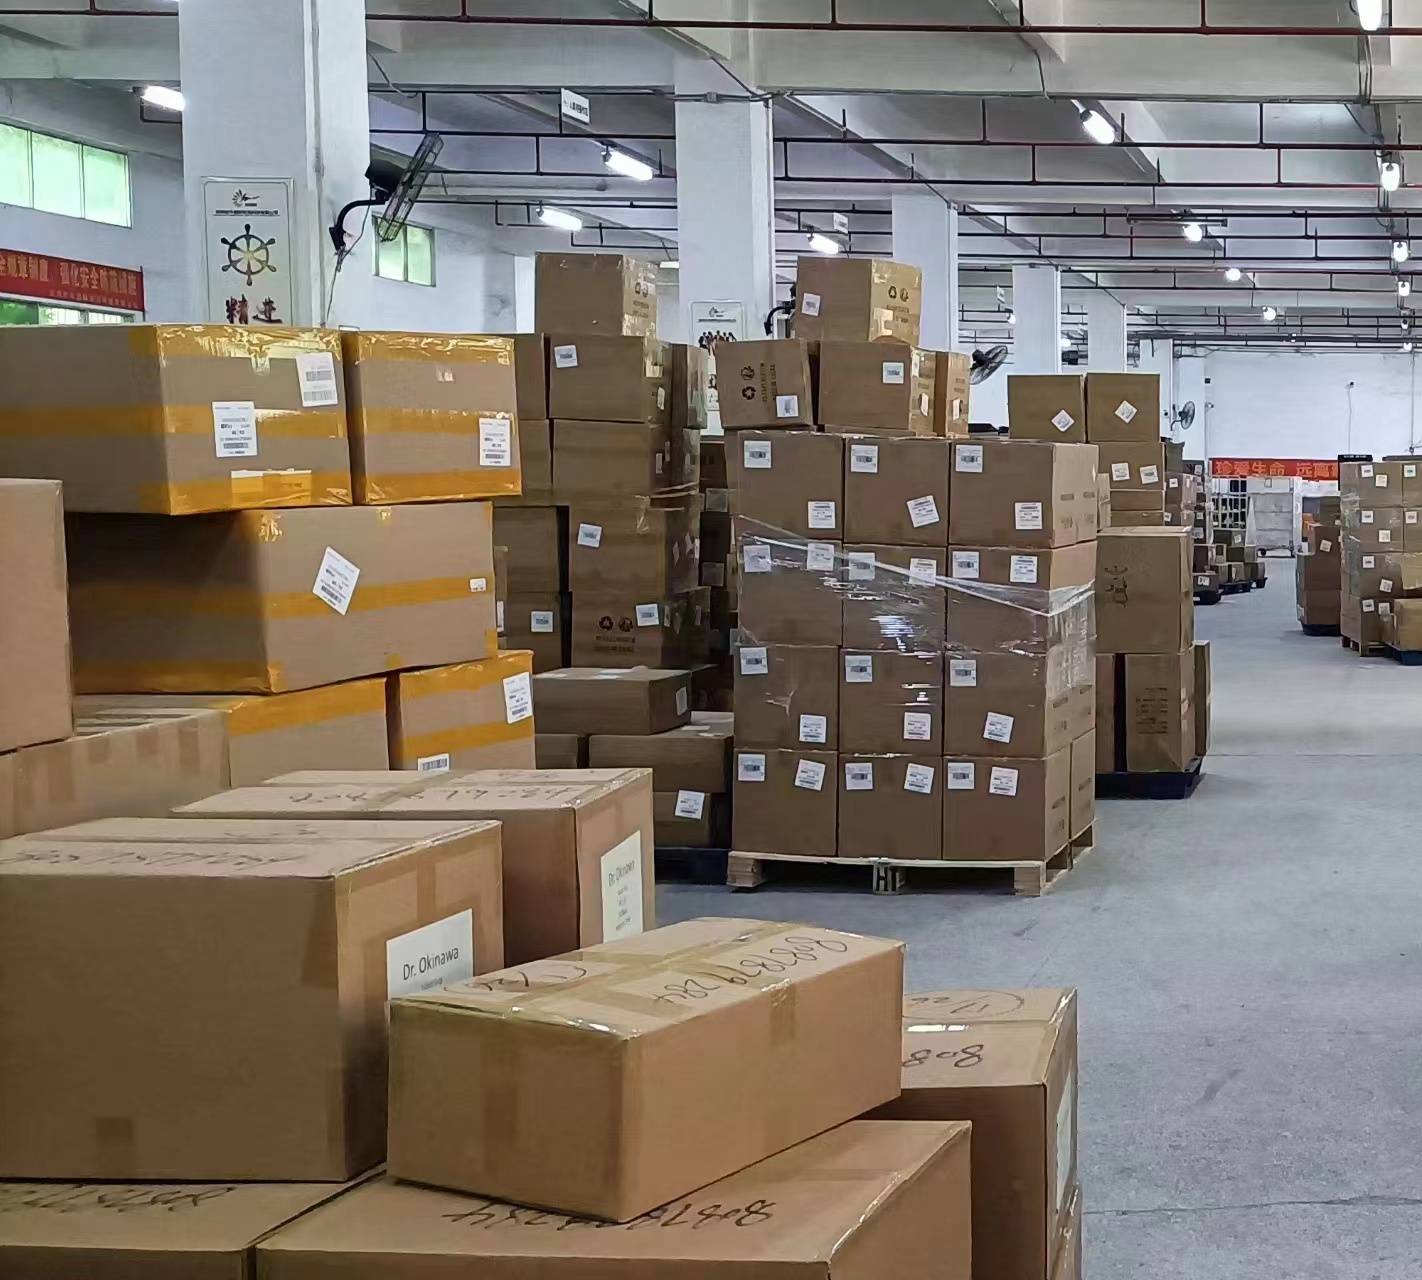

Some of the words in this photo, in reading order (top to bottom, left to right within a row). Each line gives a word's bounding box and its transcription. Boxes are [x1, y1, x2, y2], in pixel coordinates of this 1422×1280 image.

[1215, 459, 1286, 477] 珍爱生命
[403, 963, 417, 981] Dr.
[419, 947, 459, 973] Okinawa
